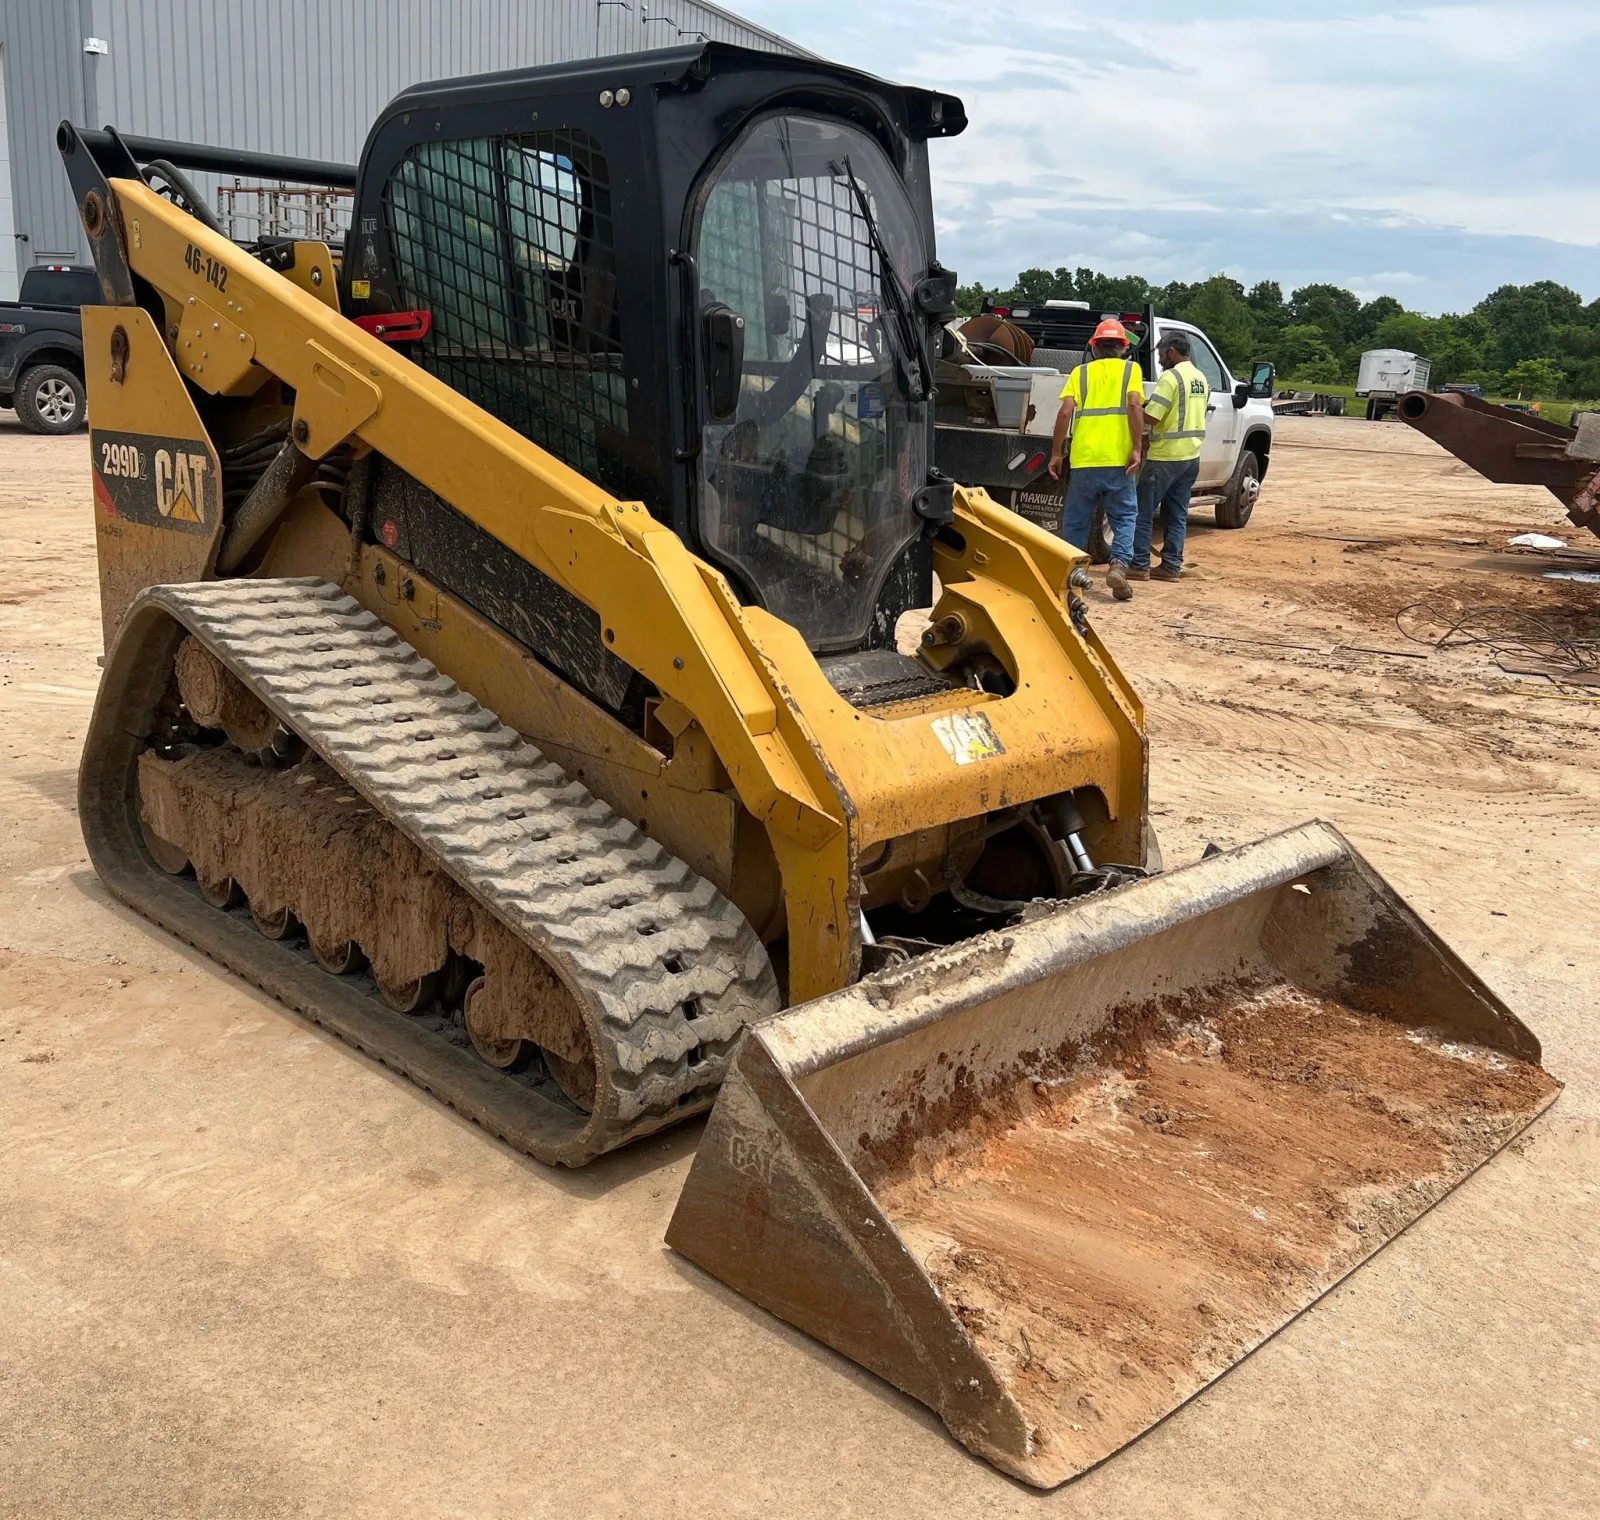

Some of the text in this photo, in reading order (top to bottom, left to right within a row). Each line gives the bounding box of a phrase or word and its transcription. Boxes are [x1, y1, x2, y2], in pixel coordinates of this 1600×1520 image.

[185, 243, 228, 294] 46-142
[551, 298, 576, 320] CAT
[154, 449, 207, 524] CAT
[1020, 491, 1064, 507] MAXWELL
[1020, 509, 1057, 519] ACCESSORIES
[730, 1135, 777, 1184] CAT
